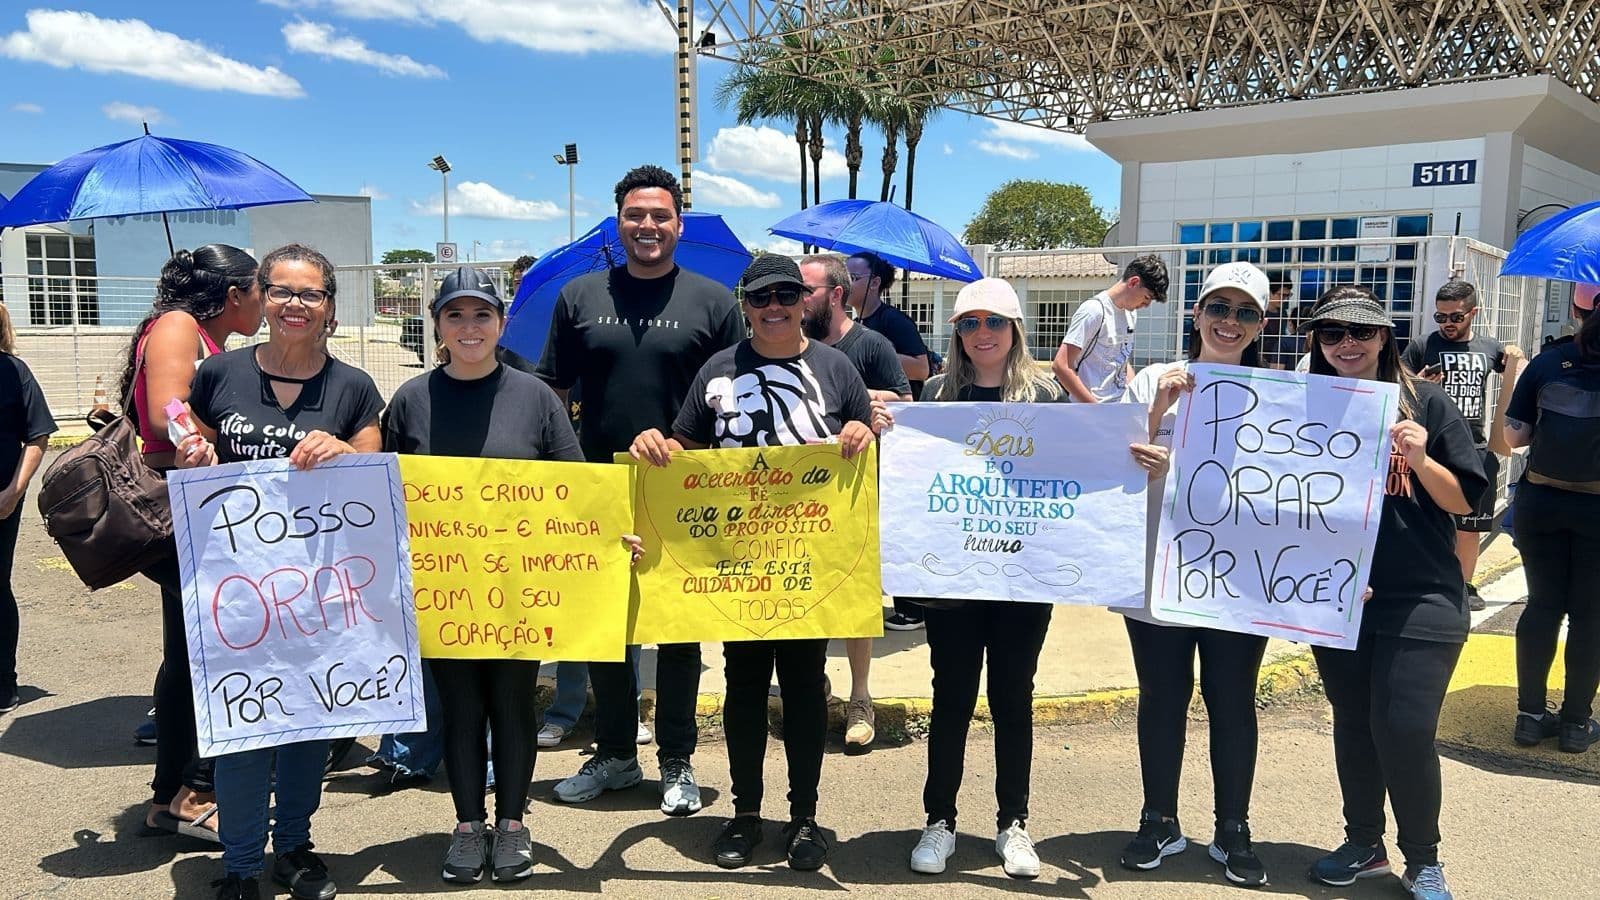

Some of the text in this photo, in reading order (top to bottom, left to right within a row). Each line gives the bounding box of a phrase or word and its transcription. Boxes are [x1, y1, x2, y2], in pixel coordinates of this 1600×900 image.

[1420, 163, 1469, 184] 5111
[597, 316, 680, 329] SEJA FORTE
[1443, 353, 1484, 371] PRA
[1444, 370, 1484, 385] JESUS
[1444, 385, 1481, 397] EU DIGO
[220, 412, 306, 441] Não colo
[1200, 380, 1362, 459] POSSO
[964, 430, 1034, 457] Deus
[752, 452, 770, 470] A
[985, 457, 1013, 475] É O
[801, 465, 831, 485] da
[402, 483, 569, 503] DEUS CRIOU O
[749, 486, 769, 502] FÉ
[927, 472, 1082, 500] ARQUITETO
[1187, 459, 1345, 534] ORAR
[676, 499, 829, 524] leva a direção
[928, 495, 1075, 519] DO UNIVERSO
[199, 484, 376, 554] POSSO
[409, 519, 488, 539] NIVERSO
[517, 519, 532, 537] E
[962, 518, 1038, 536] E DO SEU
[689, 523, 718, 539] DO
[732, 537, 810, 561] CONFIO.
[963, 534, 1024, 553] futuro
[411, 552, 600, 573] SSIM SE IMPORTA
[716, 557, 812, 577] ELE ESTÁ
[1173, 528, 1357, 612] POR VOCÊ?
[683, 575, 812, 594] CUIDANDO DE
[212, 555, 383, 651] ORAR
[413, 587, 560, 611] COM O SEU
[731, 596, 806, 621] TODOS
[439, 617, 553, 651] CORAÇÃO!
[211, 654, 408, 728] POR VOCÊ?
